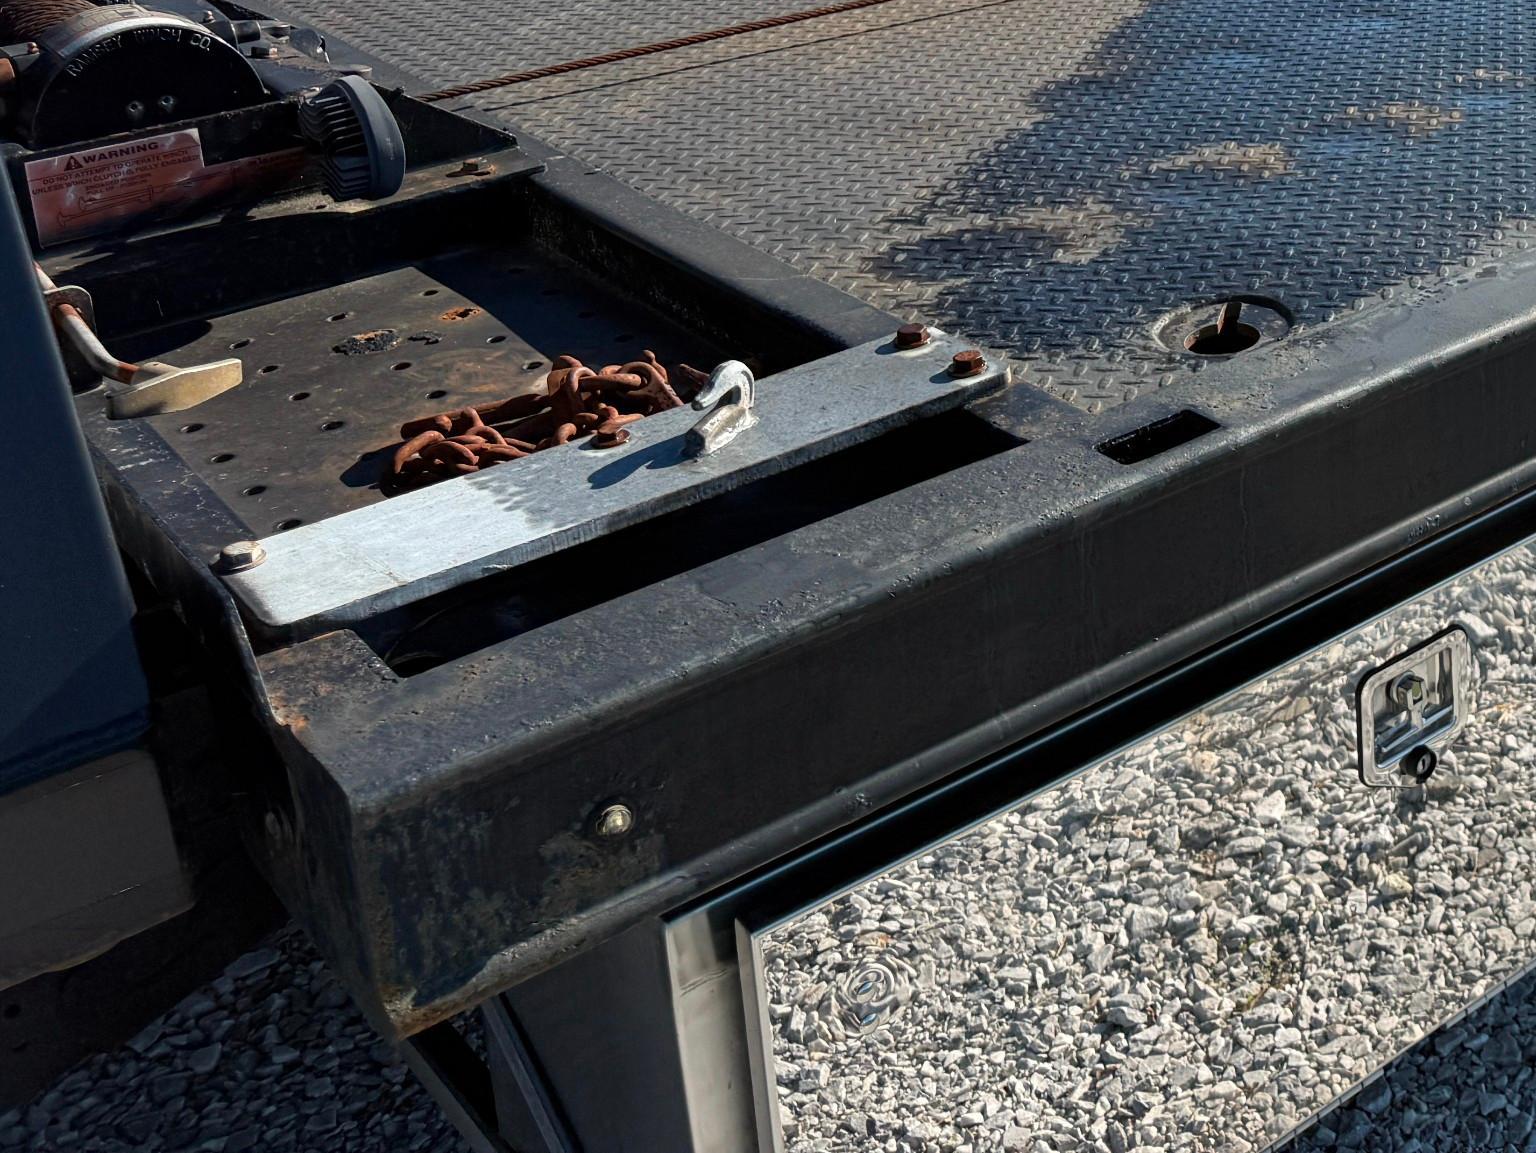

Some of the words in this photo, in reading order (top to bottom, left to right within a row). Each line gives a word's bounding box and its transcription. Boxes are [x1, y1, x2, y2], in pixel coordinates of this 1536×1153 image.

[83, 142, 159, 163] WARNING
[56, 173, 73, 181] NOT
[74, 166, 111, 178] ATTEMPT
[32, 183, 64, 195] UNLESS
[64, 178, 92, 188] WINCH
